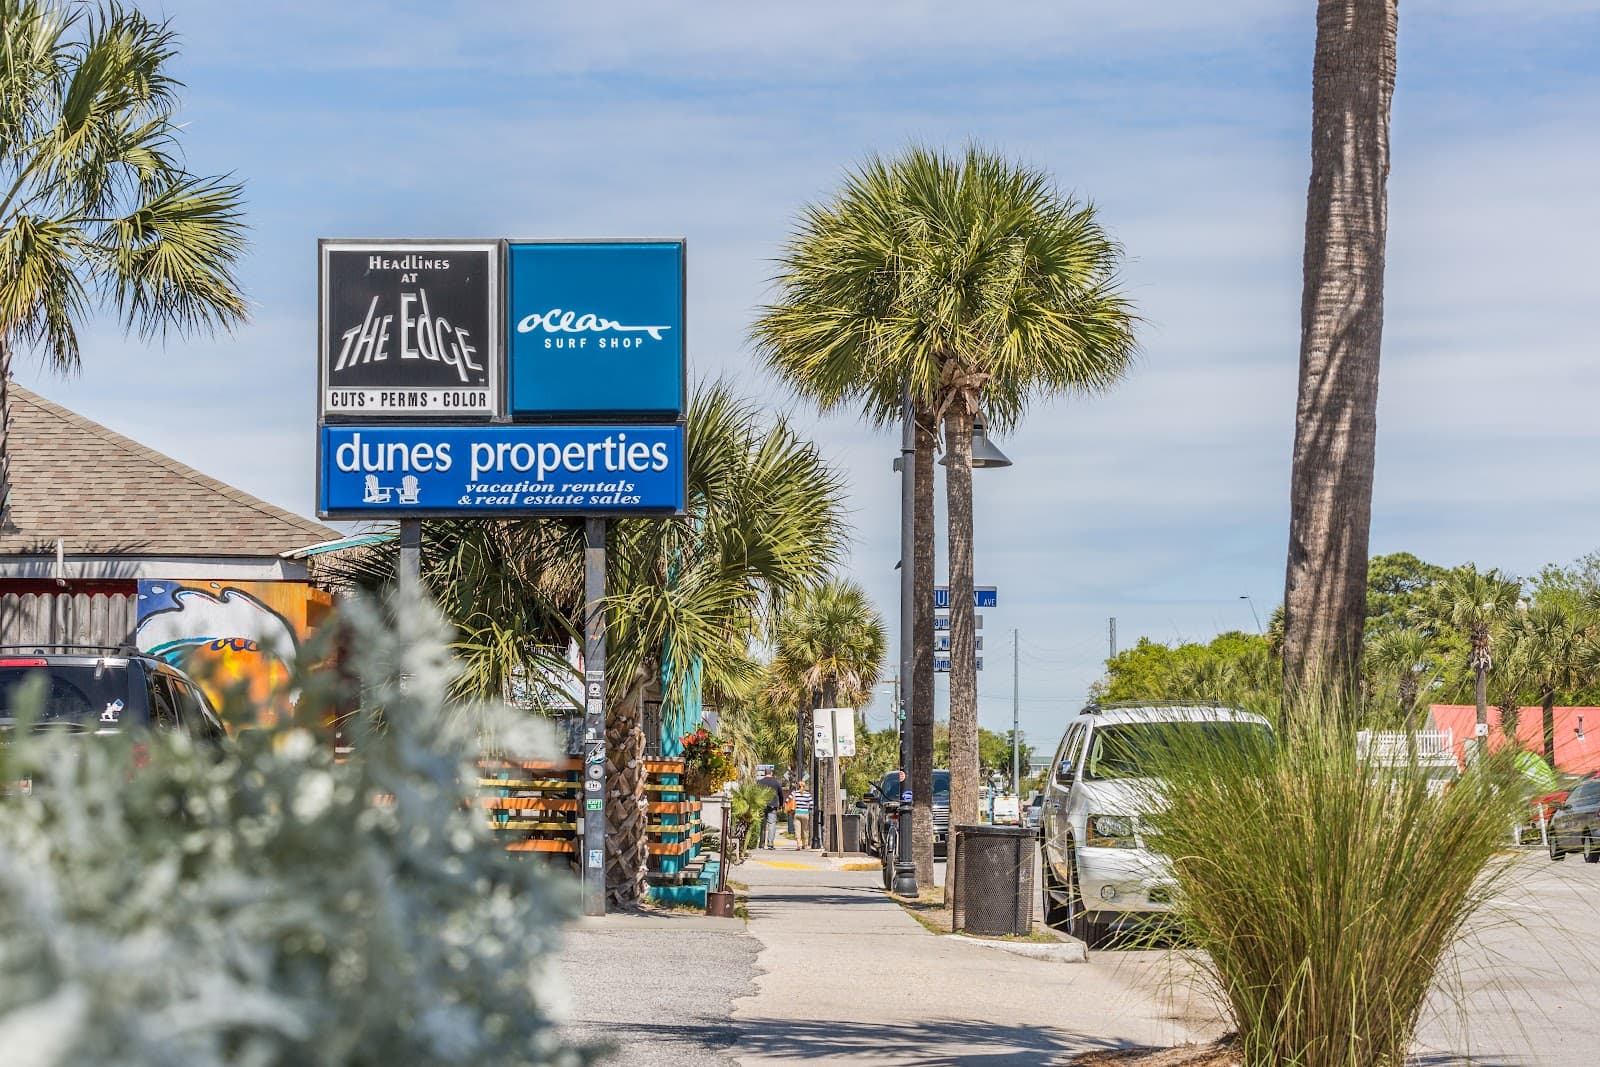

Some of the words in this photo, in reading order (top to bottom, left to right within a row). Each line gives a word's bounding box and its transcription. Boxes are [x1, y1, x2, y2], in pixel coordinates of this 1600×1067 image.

[401, 273, 418, 283] AT
[517, 308, 671, 340] ocean
[334, 296, 393, 372] THE
[545, 338, 587, 349] SURF
[599, 338, 643, 348] SHOP
[331, 392, 365, 407] CUTS
[381, 392, 428, 407] PERMS
[443, 392, 487, 407] COLOR
[336, 433, 452, 472] dunes
[471, 433, 668, 481] properties
[465, 481, 555, 493] vacation
[561, 480, 635, 493] rentals
[523, 494, 584, 505] estate
[589, 493, 641, 505] sales
[983, 598, 996, 607] AVE
